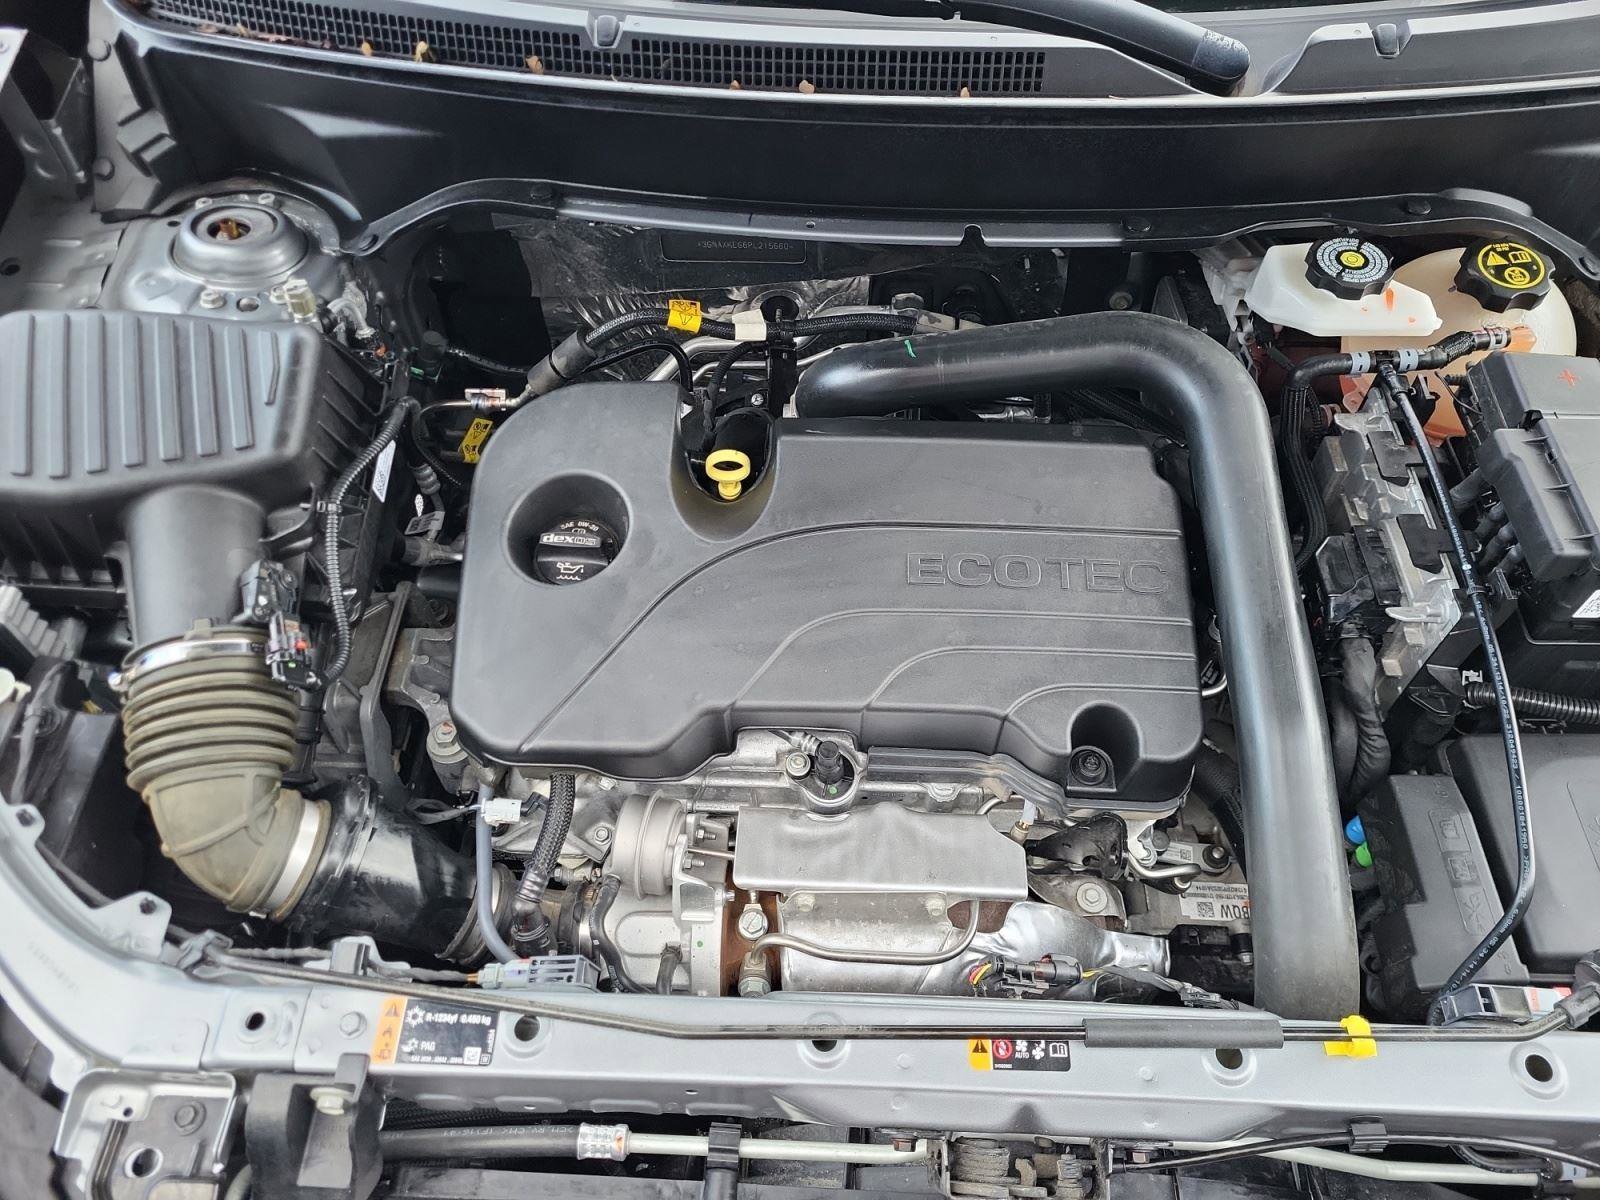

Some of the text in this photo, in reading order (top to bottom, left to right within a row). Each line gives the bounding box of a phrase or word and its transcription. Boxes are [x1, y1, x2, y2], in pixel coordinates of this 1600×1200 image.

[560, 520, 600, 532] SAE 0W-20
[906, 552, 1169, 594] ECOTEC
[481, 1015, 492, 1026] kg
[1014, 1051, 1030, 1059] AUTO
